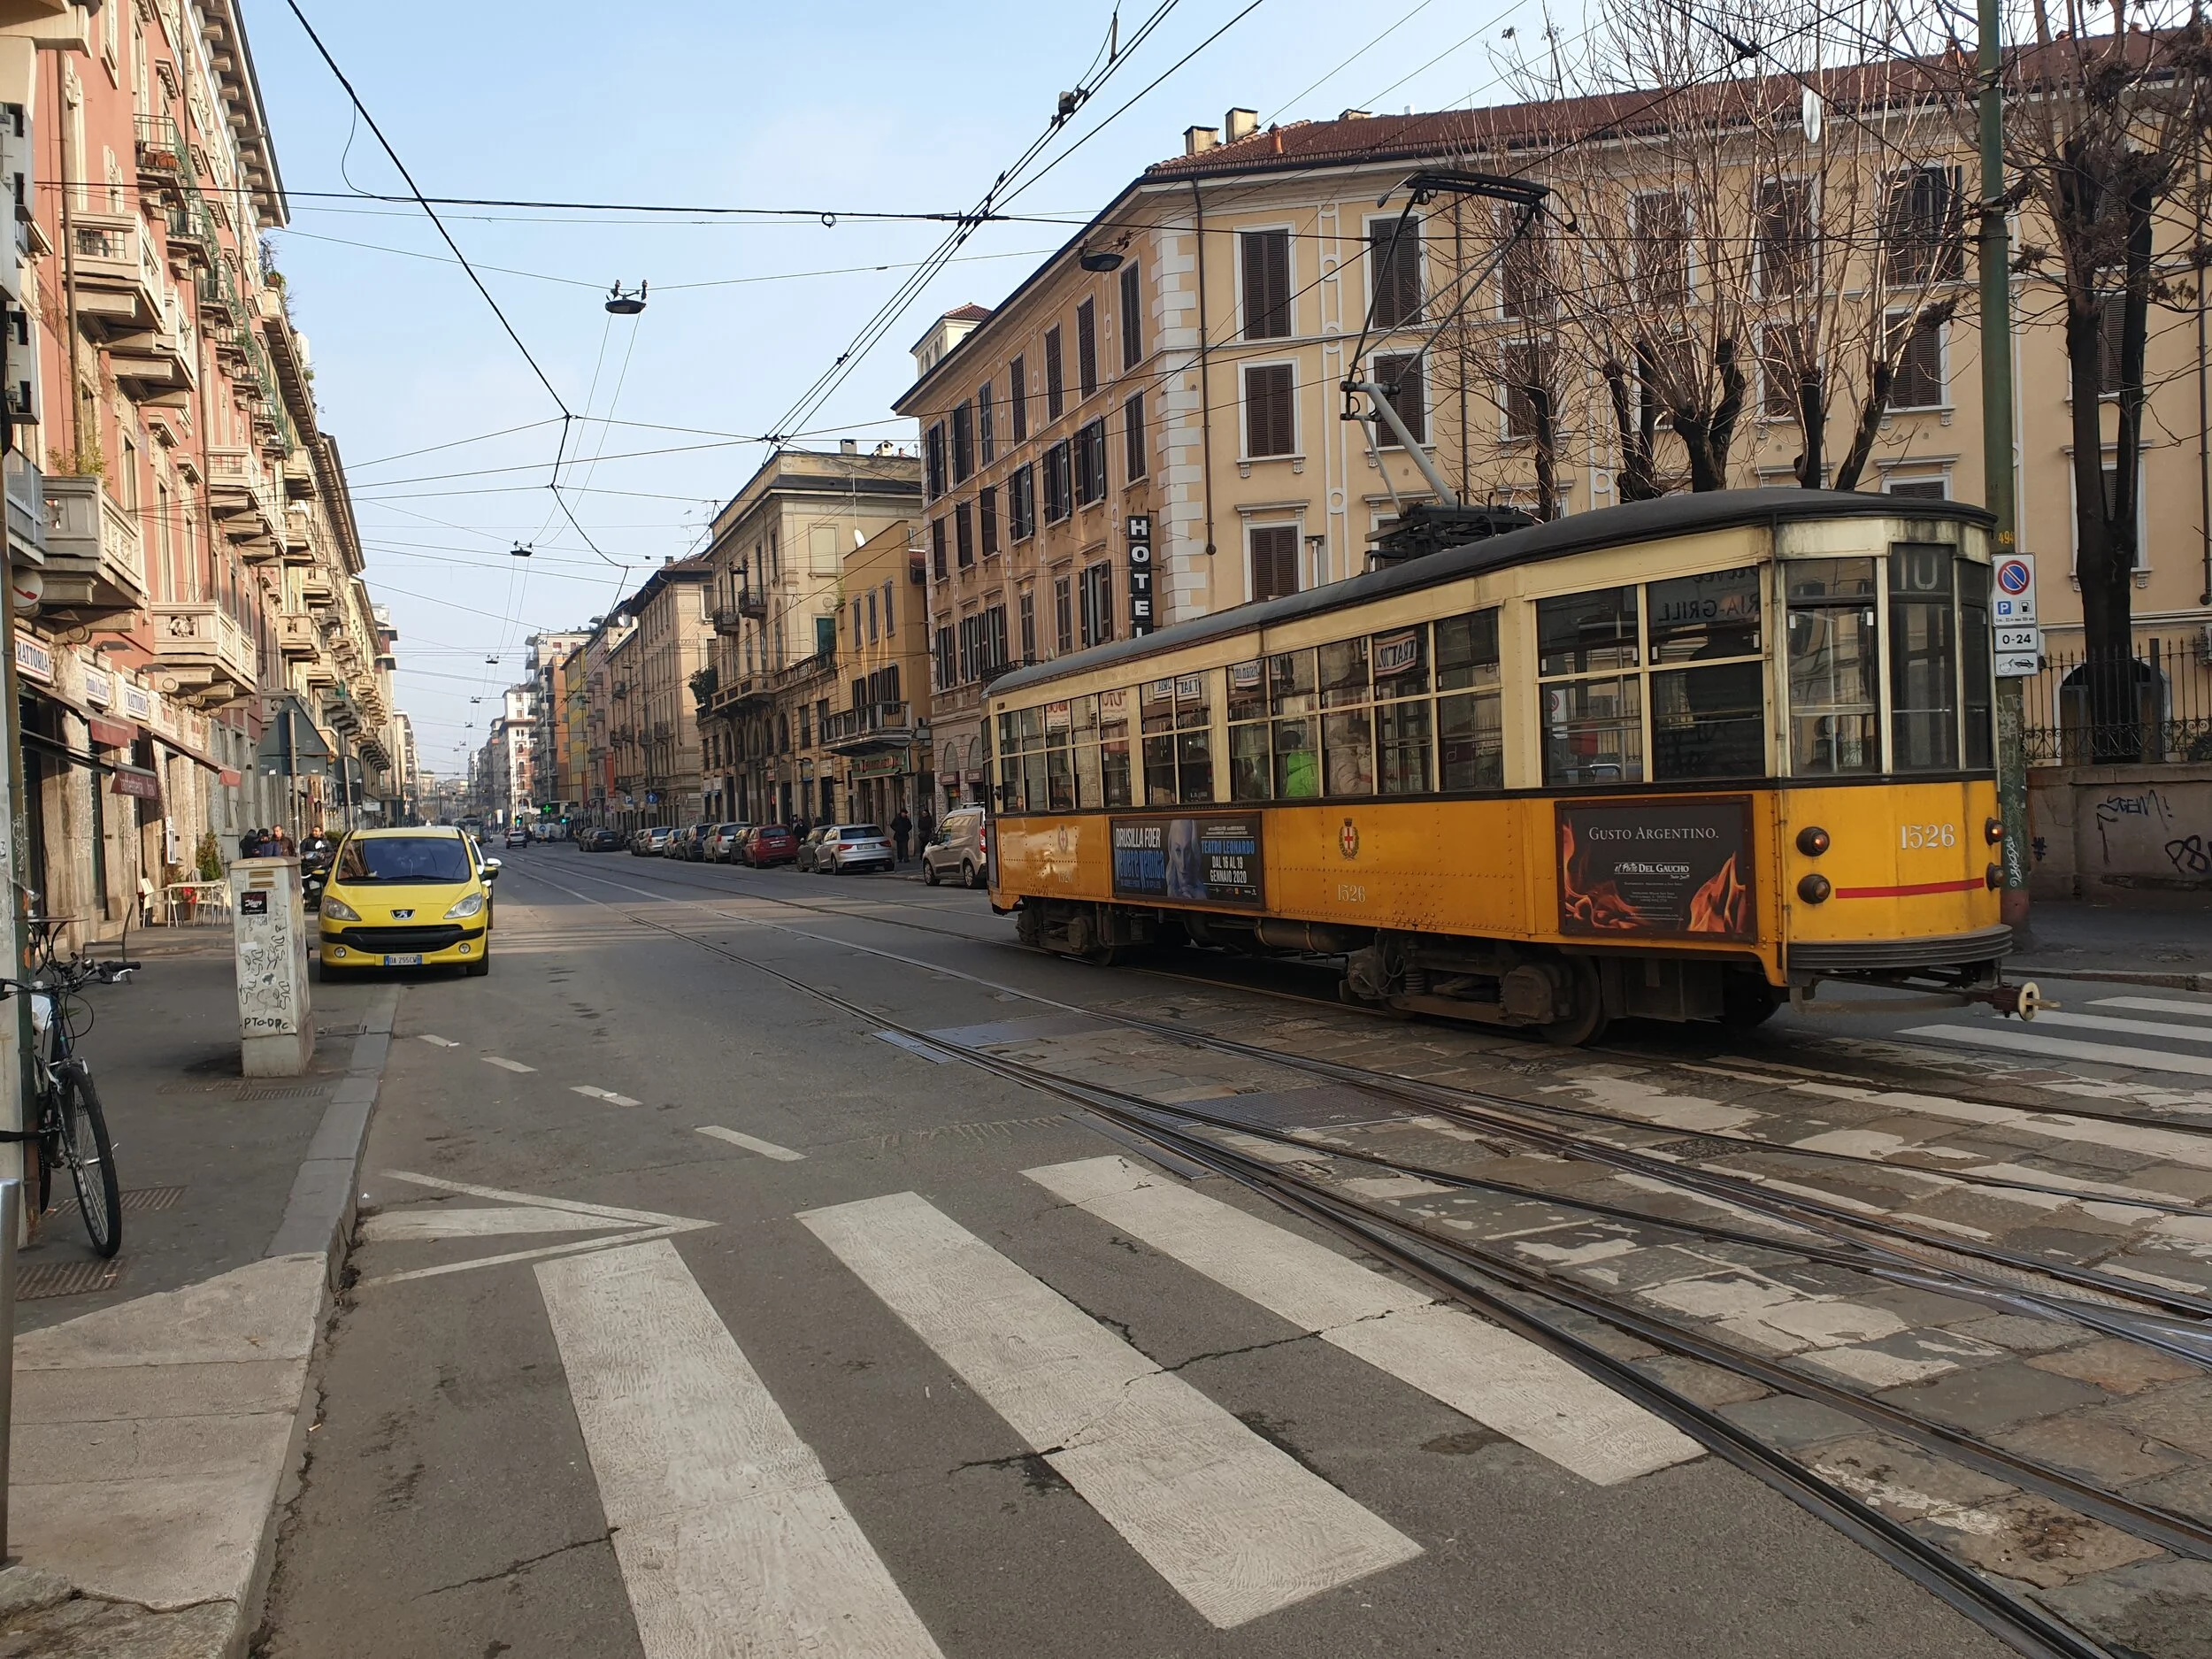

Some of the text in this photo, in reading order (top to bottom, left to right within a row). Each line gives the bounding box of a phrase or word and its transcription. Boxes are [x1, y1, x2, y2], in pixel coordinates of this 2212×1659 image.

[2002, 634, 2032, 644] 0-24
[15, 641, 49, 672] RATTORIA
[1116, 827, 1161, 849] DRUSILLA FOER
[1588, 826, 1719, 841] GUSTO ARGENTINO.
[1901, 823, 1955, 849] 1526
[1202, 840, 1255, 855] TEATRO LEONARDO
[1211, 856, 1243, 869] DAL 16 AL 19
[1639, 864, 1655, 872] DEL
[1655, 864, 1690, 872] GAUCHO
[1210, 870, 1247, 884] GENNAIO 2020
[1338, 885, 1366, 903] 1526
